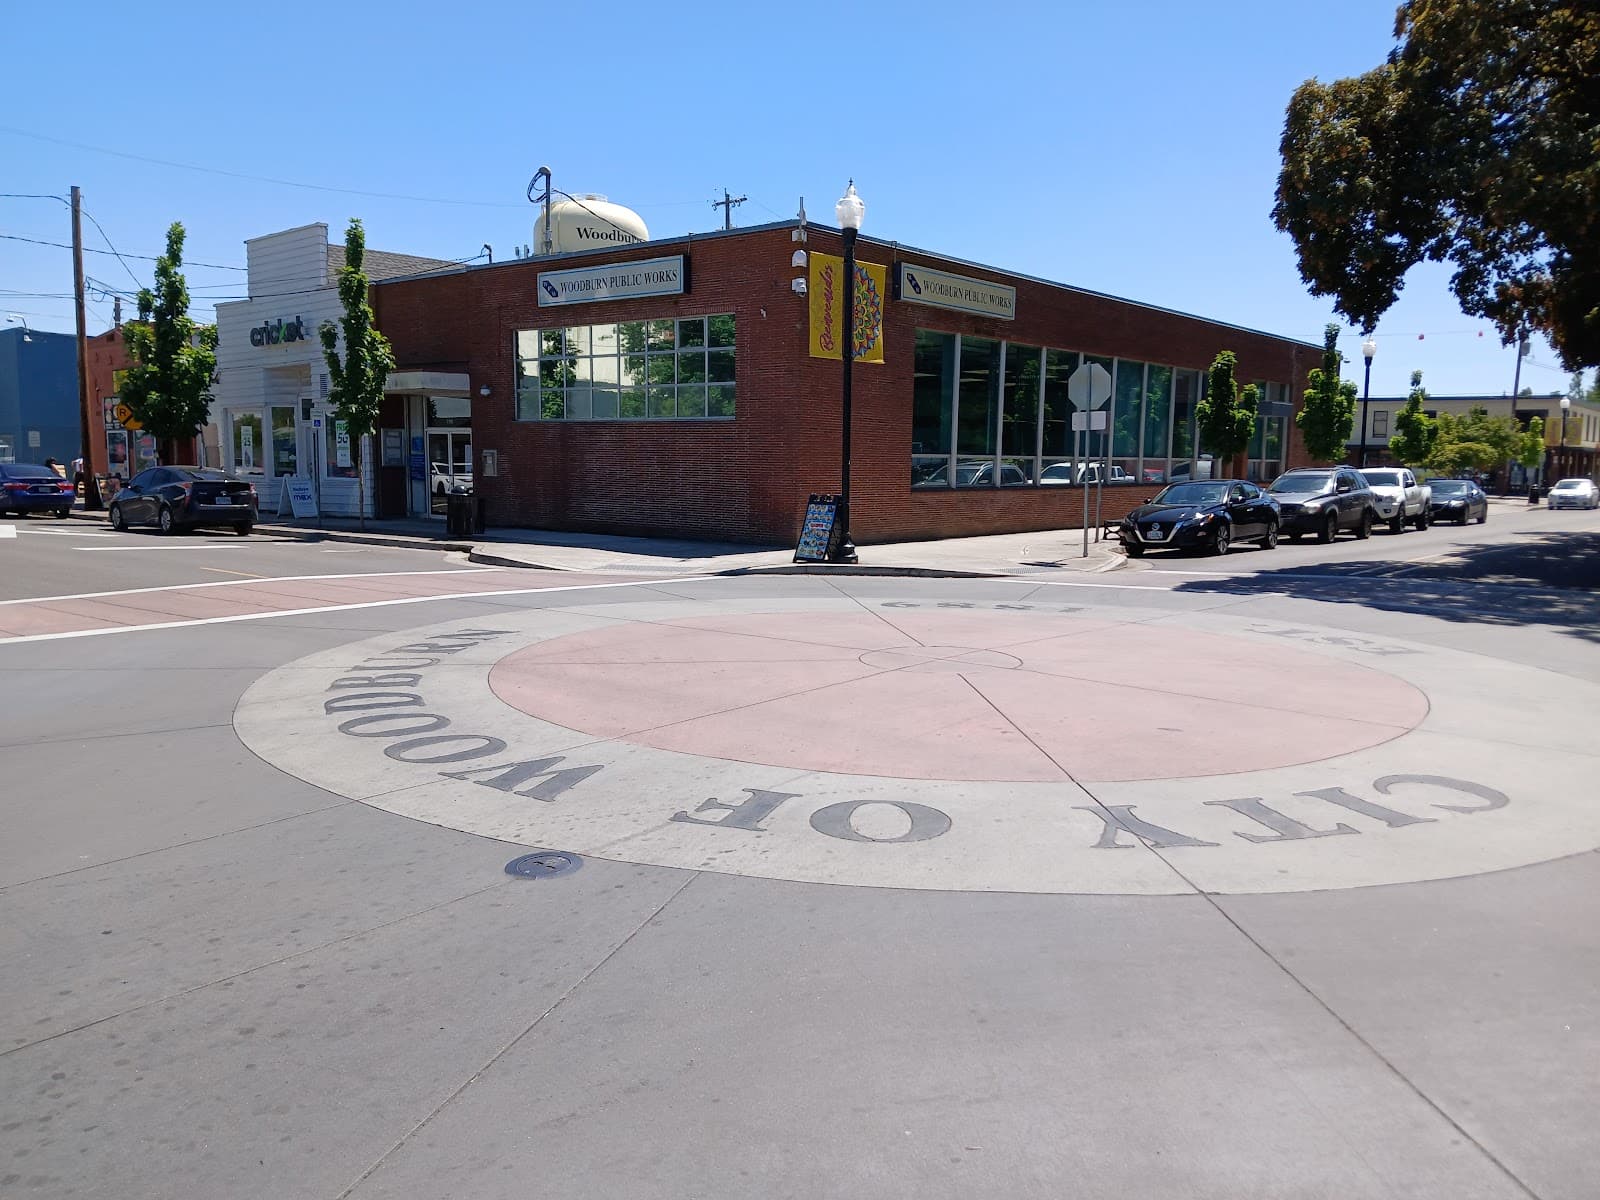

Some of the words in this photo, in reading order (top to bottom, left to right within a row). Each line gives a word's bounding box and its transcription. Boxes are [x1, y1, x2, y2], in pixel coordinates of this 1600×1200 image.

[560, 277, 608, 294] WOODBURN
[610, 273, 642, 288] PUBLIC
[644, 269, 678, 284] WORKS
[923, 279, 963, 300] WOODBURN
[965, 289, 988, 305] PUBLIC
[989, 294, 1012, 309] WORKS
[250, 315, 305, 347] cricket
[325, 628, 604, 802] WOODBURN
[669, 787, 953, 843] OF
[1071, 773, 1510, 850] CITY
